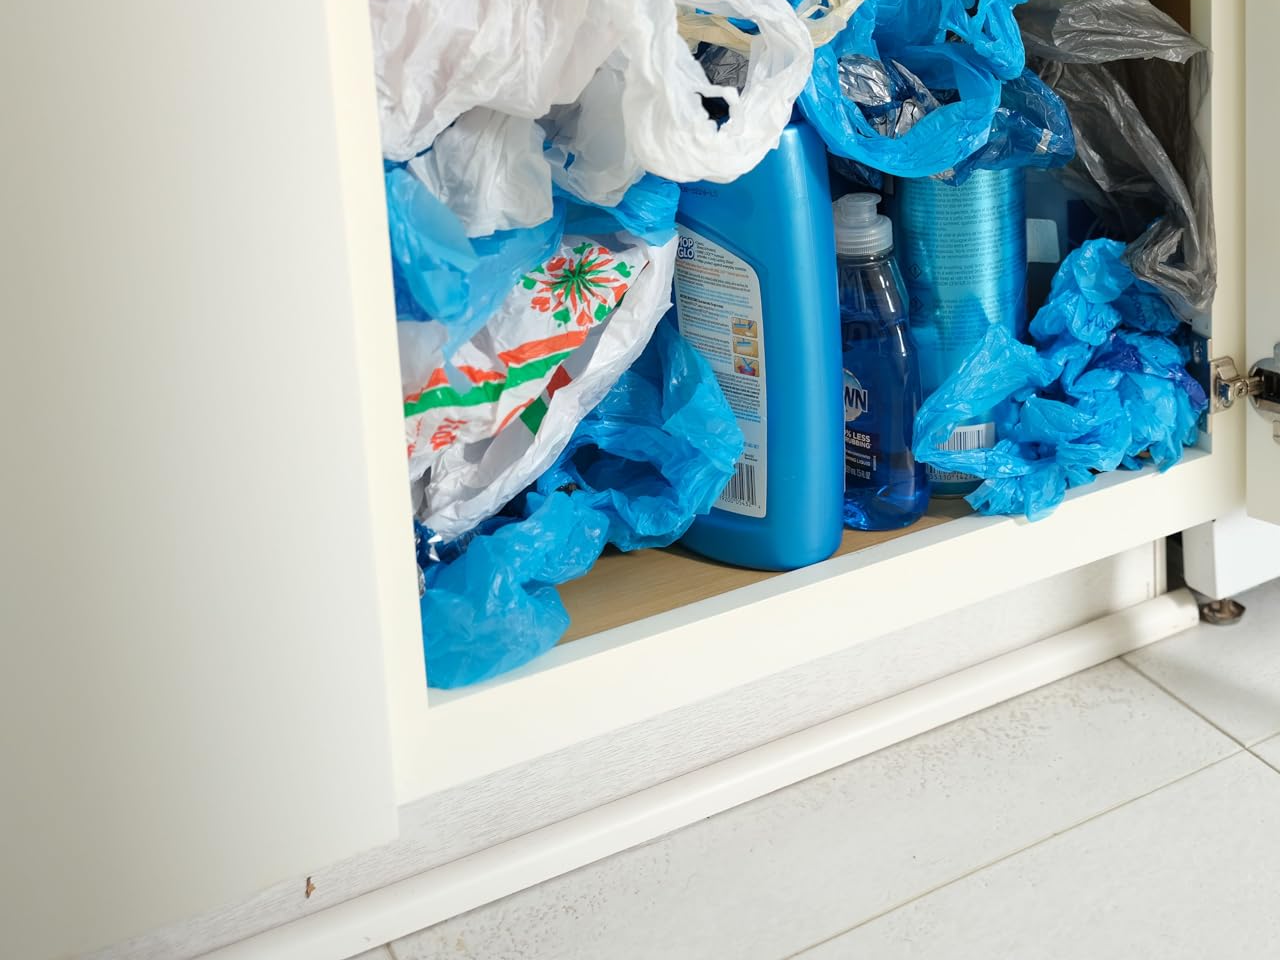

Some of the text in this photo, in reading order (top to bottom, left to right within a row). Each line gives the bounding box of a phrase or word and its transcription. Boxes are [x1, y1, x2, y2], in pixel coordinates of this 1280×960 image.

[677, 247, 694, 258] GLO
[844, 386, 868, 412] WN
[852, 432, 871, 443] LESS
